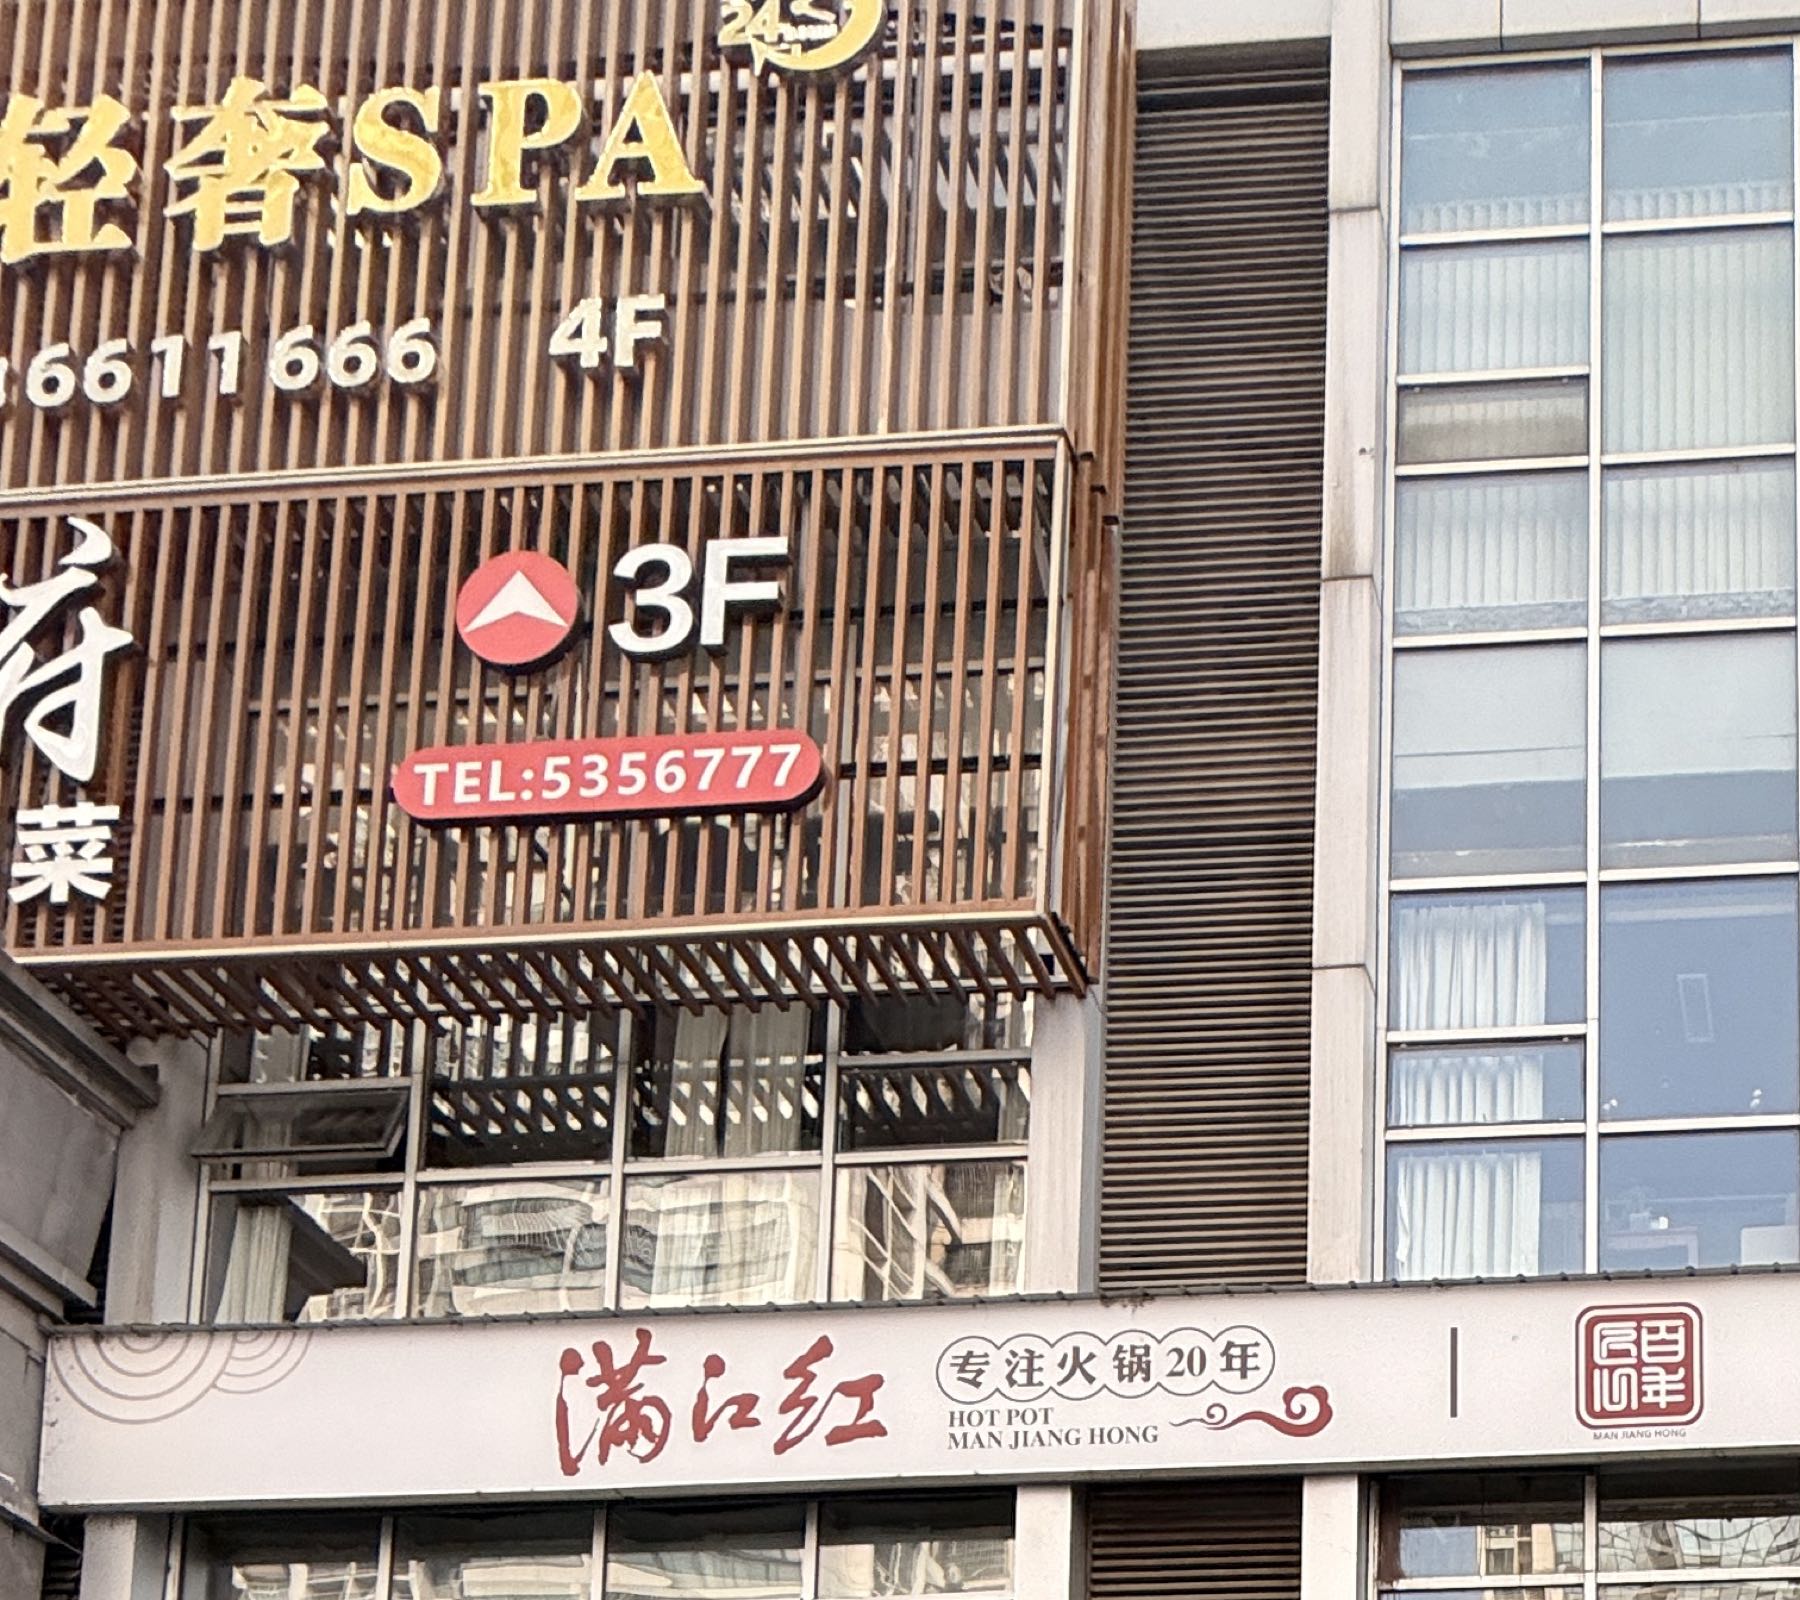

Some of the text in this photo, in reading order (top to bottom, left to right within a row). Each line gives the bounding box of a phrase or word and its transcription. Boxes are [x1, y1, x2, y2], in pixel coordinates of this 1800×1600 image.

[0, 294, 668, 408] 6611666 4F
[609, 535, 791, 659] 3F
[413, 743, 802, 808] TEL:5356777
[948, 1339, 1263, 1388] 专注火锅20年
[555, 1326, 889, 1477] 满江红
[948, 1407, 1055, 1428] HOT POT
[948, 1425, 1160, 1450] MAN JIANG HONG
